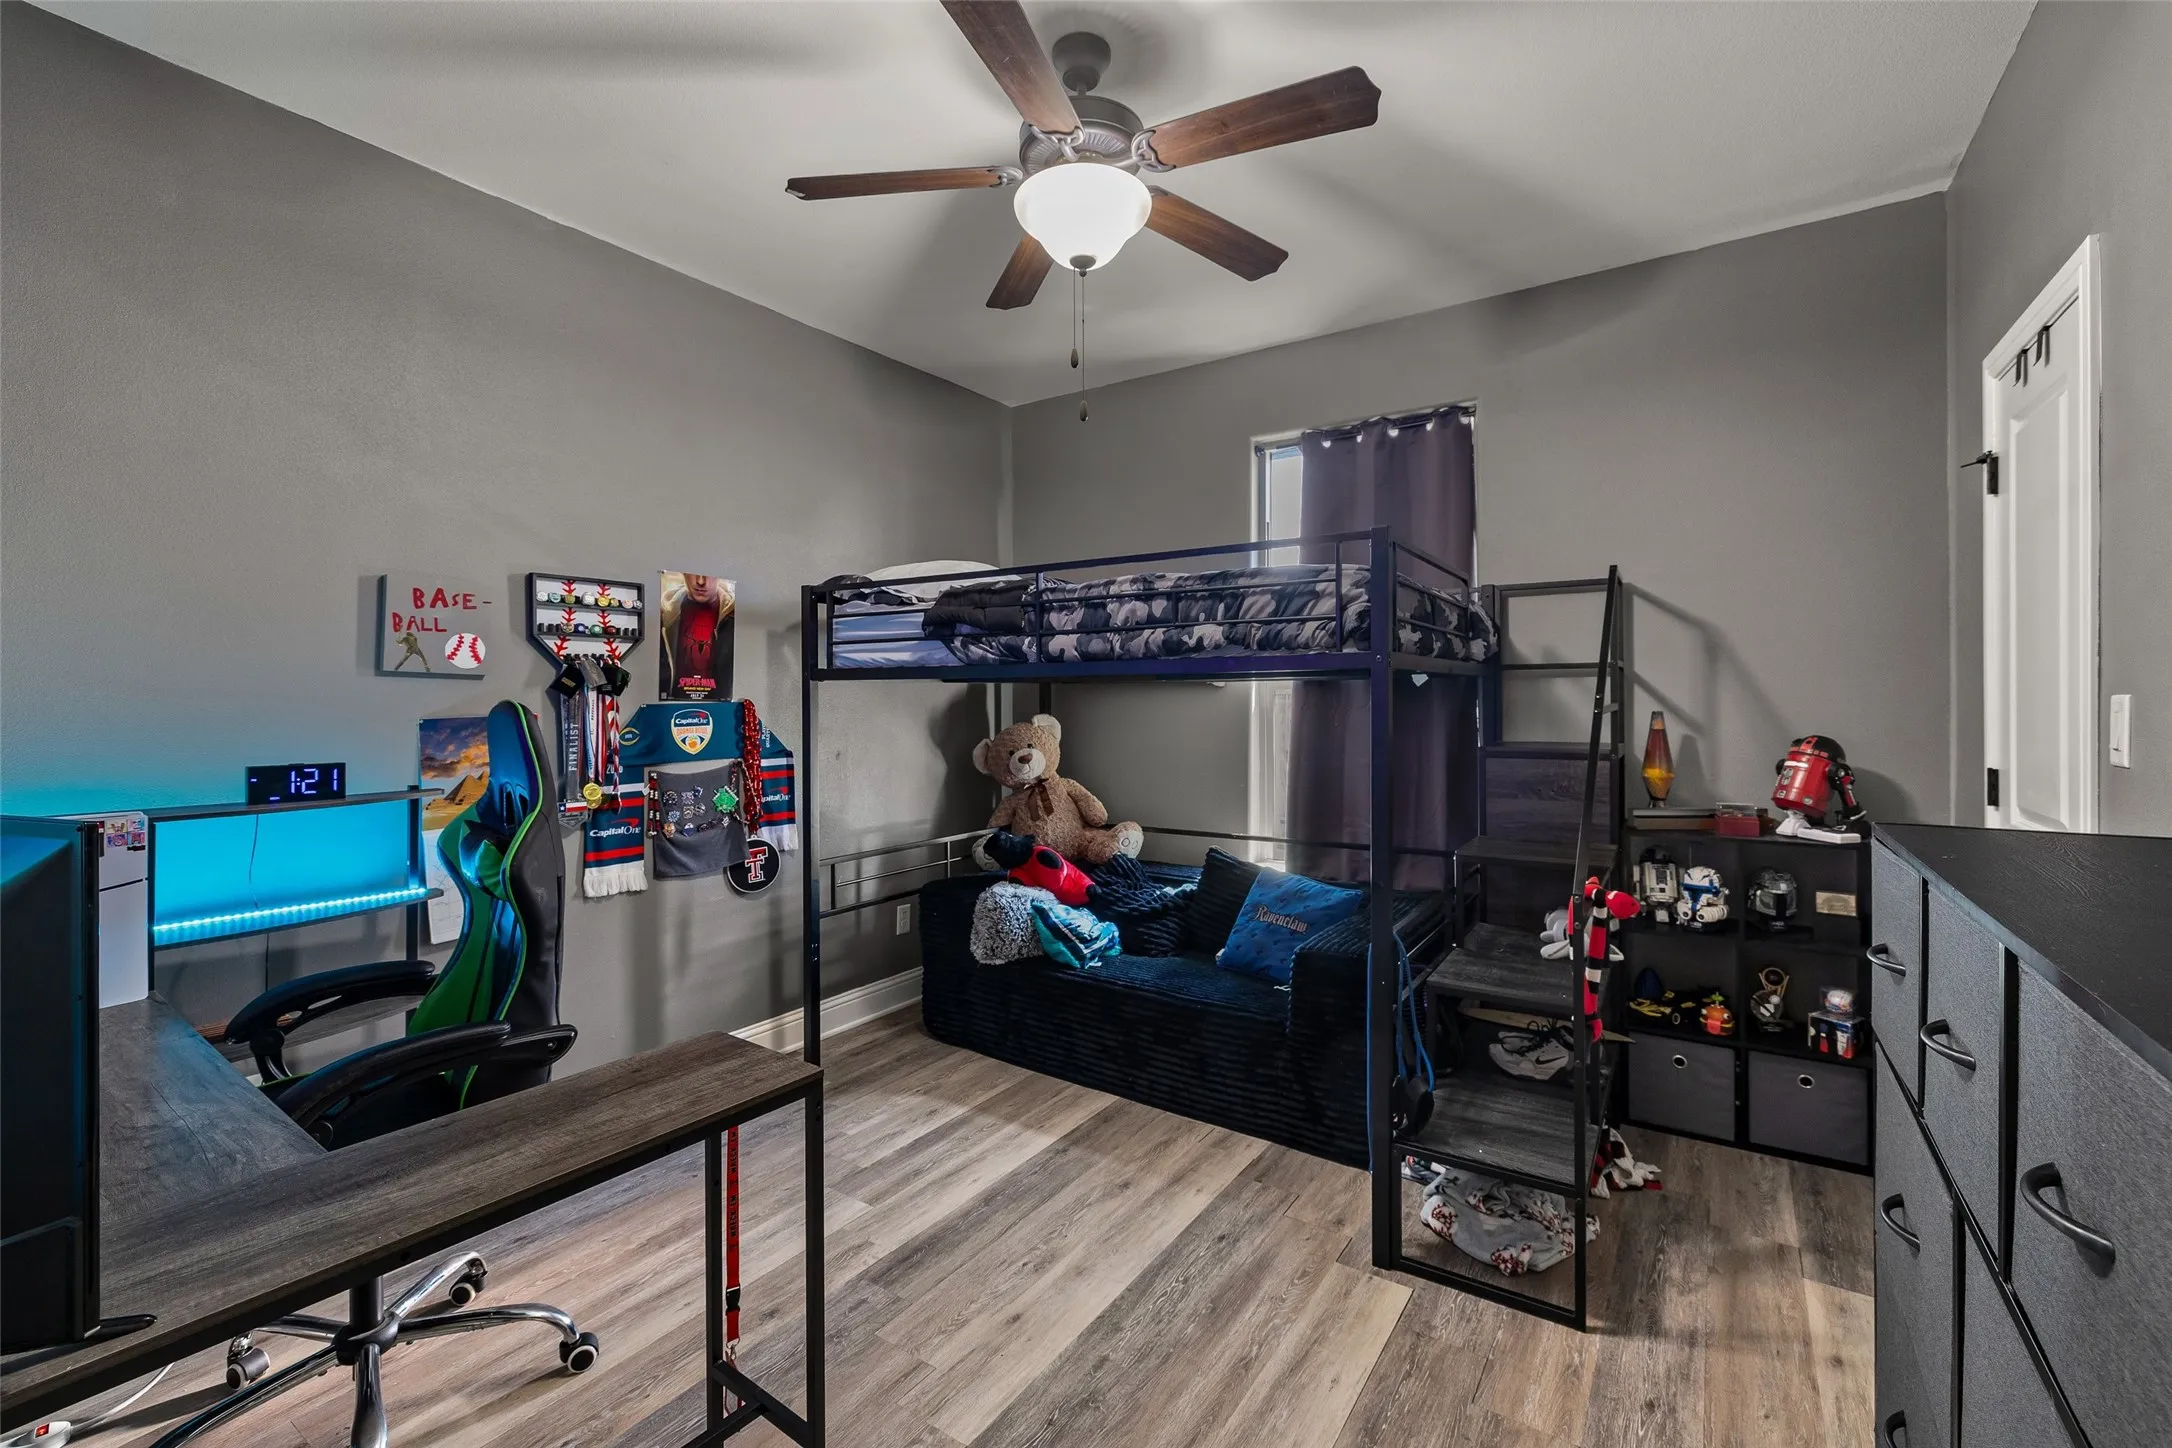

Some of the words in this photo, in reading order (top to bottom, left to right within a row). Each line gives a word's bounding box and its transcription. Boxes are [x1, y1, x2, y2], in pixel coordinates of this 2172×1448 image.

[412, 587, 492, 609] BASE-
[392, 612, 447, 632] BALL
[678, 678, 716, 689] SPIDER-MAN
[568, 722, 579, 771] FINALIST
[290, 768, 338, 794] 1:21
[1254, 905, 1309, 934] Ravenclaw
